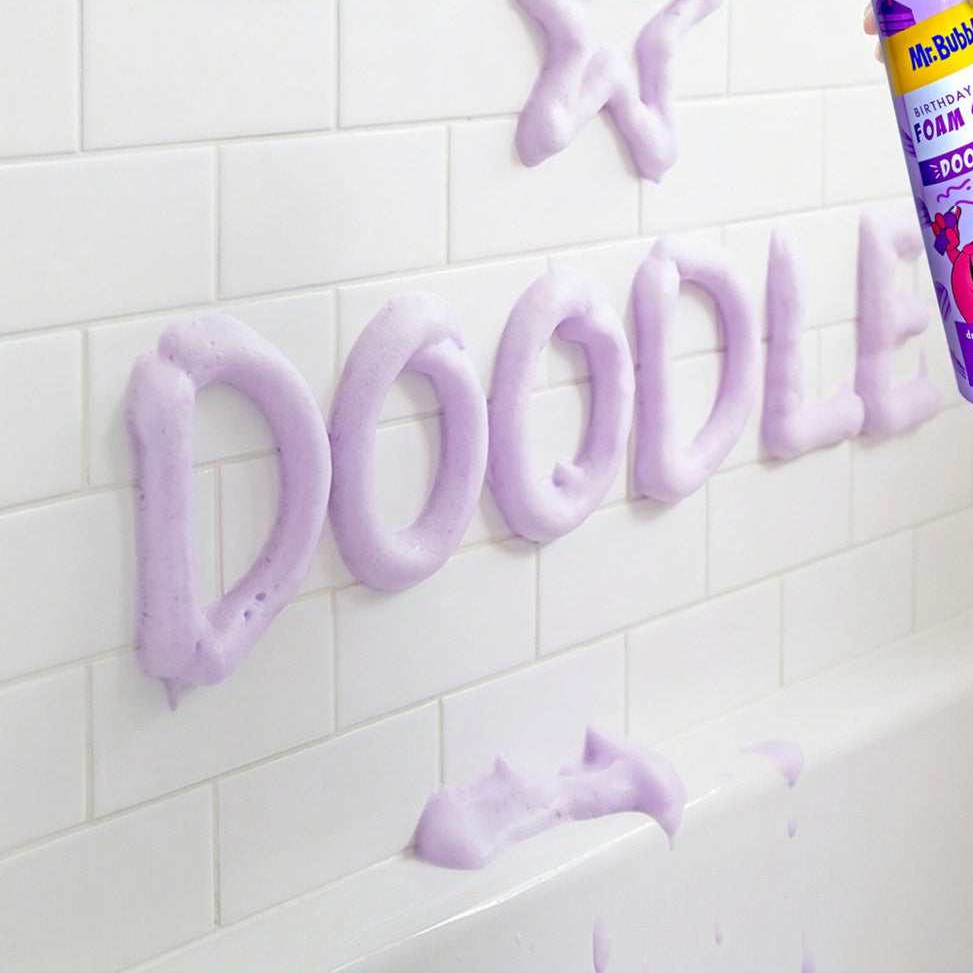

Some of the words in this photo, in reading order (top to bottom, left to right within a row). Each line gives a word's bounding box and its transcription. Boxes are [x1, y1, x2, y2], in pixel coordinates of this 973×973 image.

[913, 85, 972, 118] BIRTHDAY
[913, 107, 965, 144] FOAM
[125, 211, 945, 702] DOODLE
